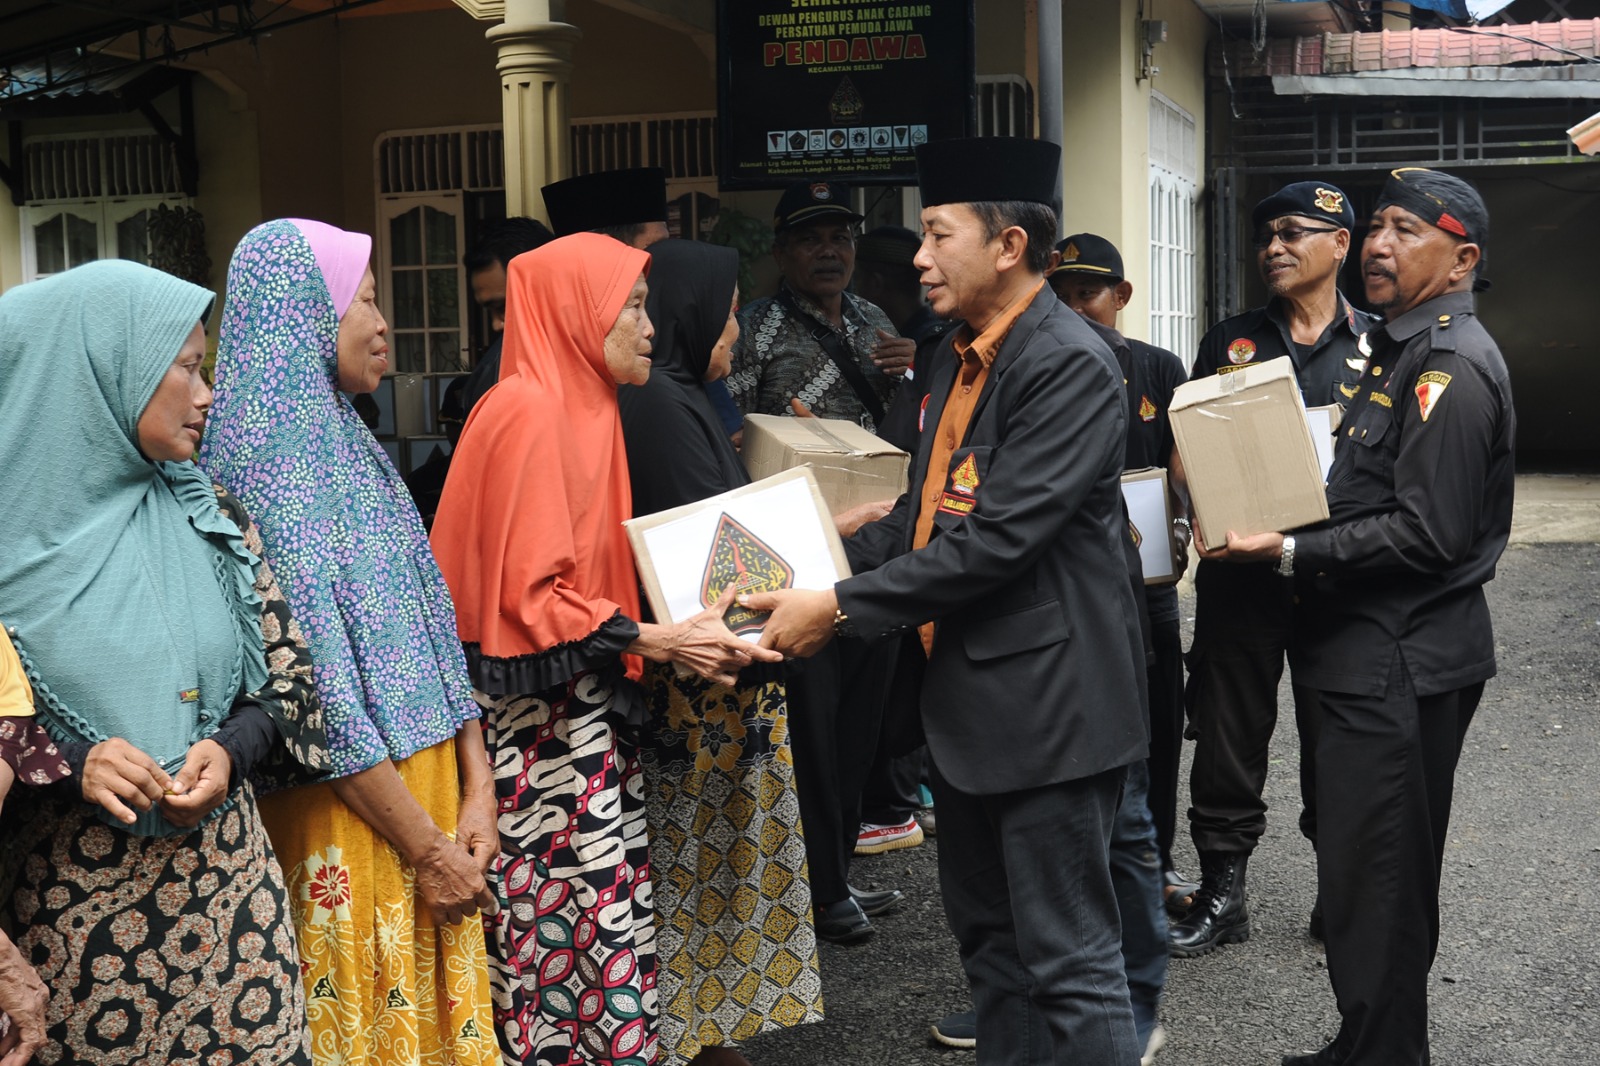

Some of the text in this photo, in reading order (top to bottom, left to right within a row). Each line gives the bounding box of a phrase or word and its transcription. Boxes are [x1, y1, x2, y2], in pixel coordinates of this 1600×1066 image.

[759, 4, 931, 26] DEWAN PENGURUS ANAK CABANG
[776, 19, 914, 38] PERSATUAN PEMUDA JAWA
[764, 34, 927, 67] PENDAWA
[808, 63, 883, 73] KECAMATAN SELESAI
